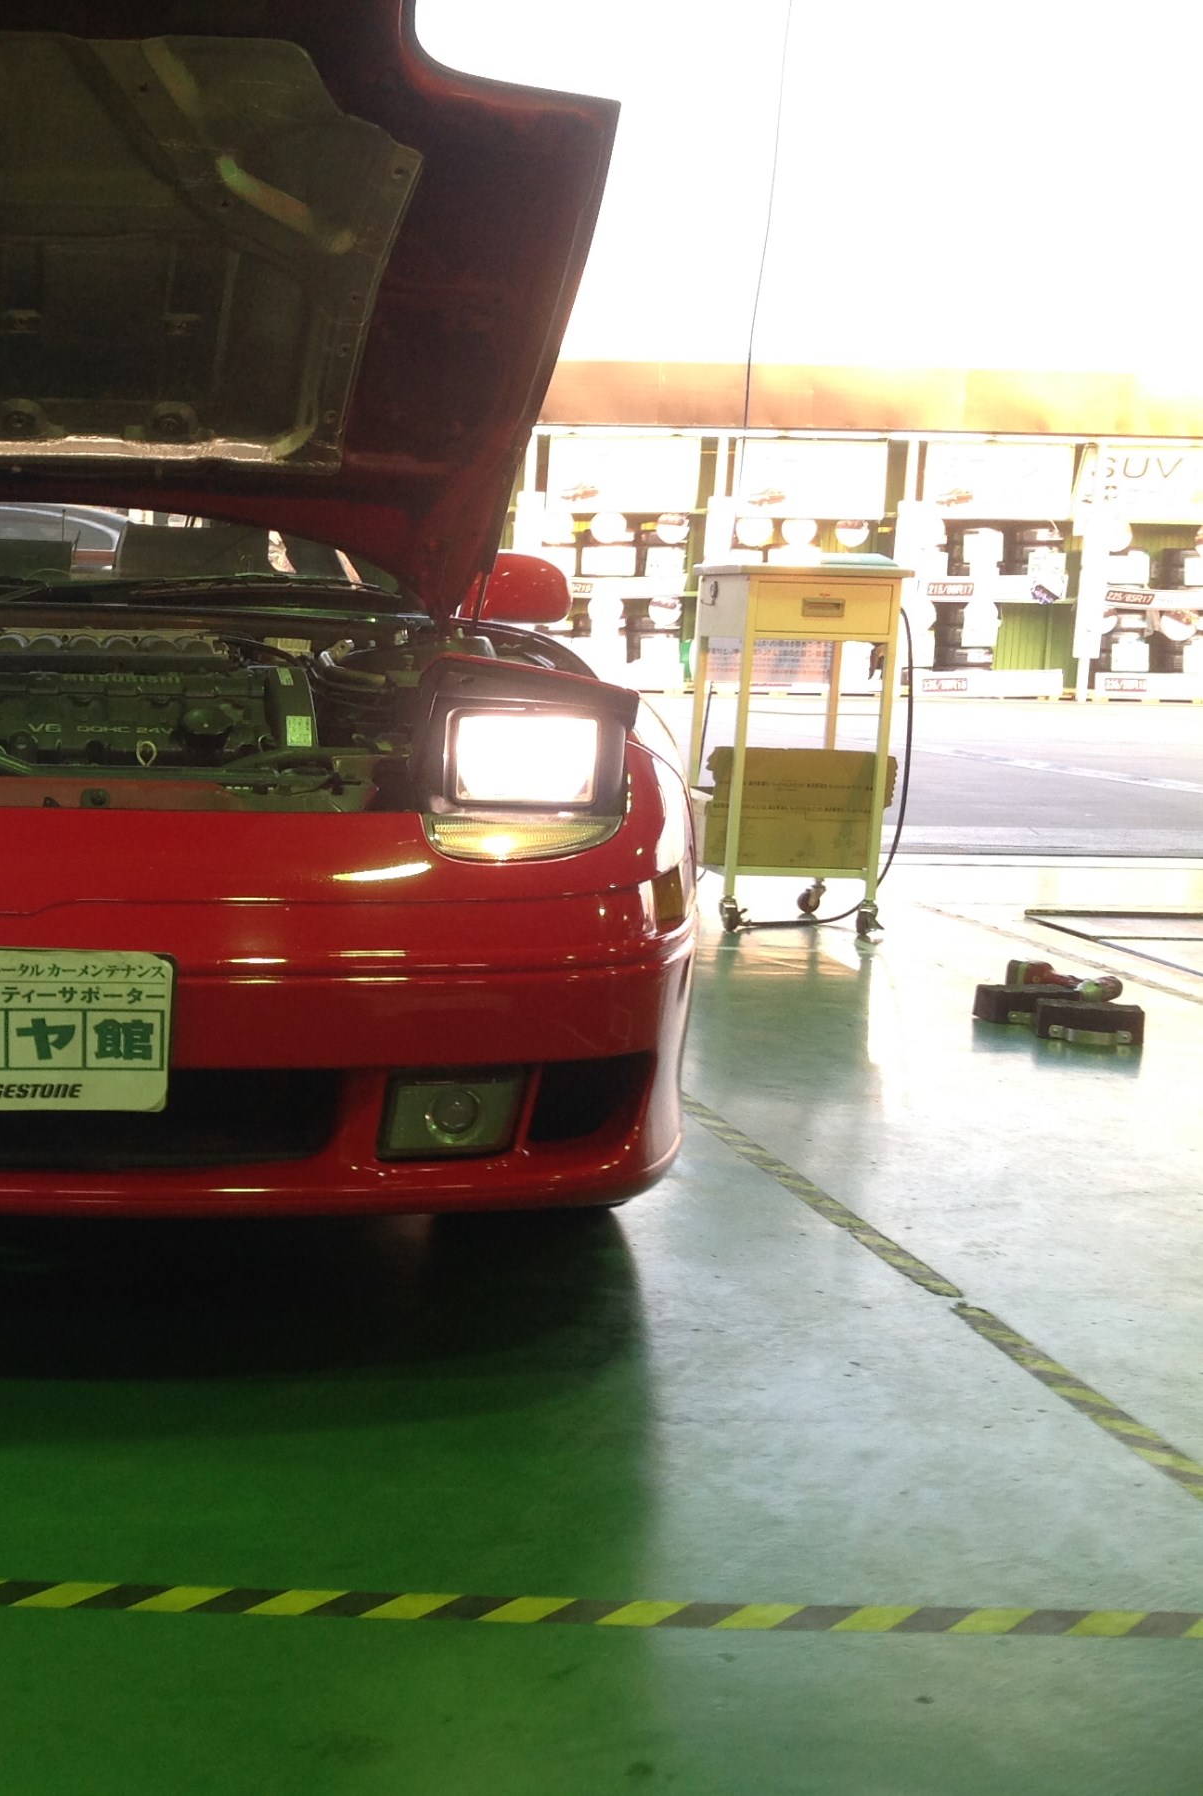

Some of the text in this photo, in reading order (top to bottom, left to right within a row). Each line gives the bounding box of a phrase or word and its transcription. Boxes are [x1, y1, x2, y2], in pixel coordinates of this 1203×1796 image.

[1105, 457, 1183, 478] SUV
[27, 723, 174, 735] V6 DOHC 24V
